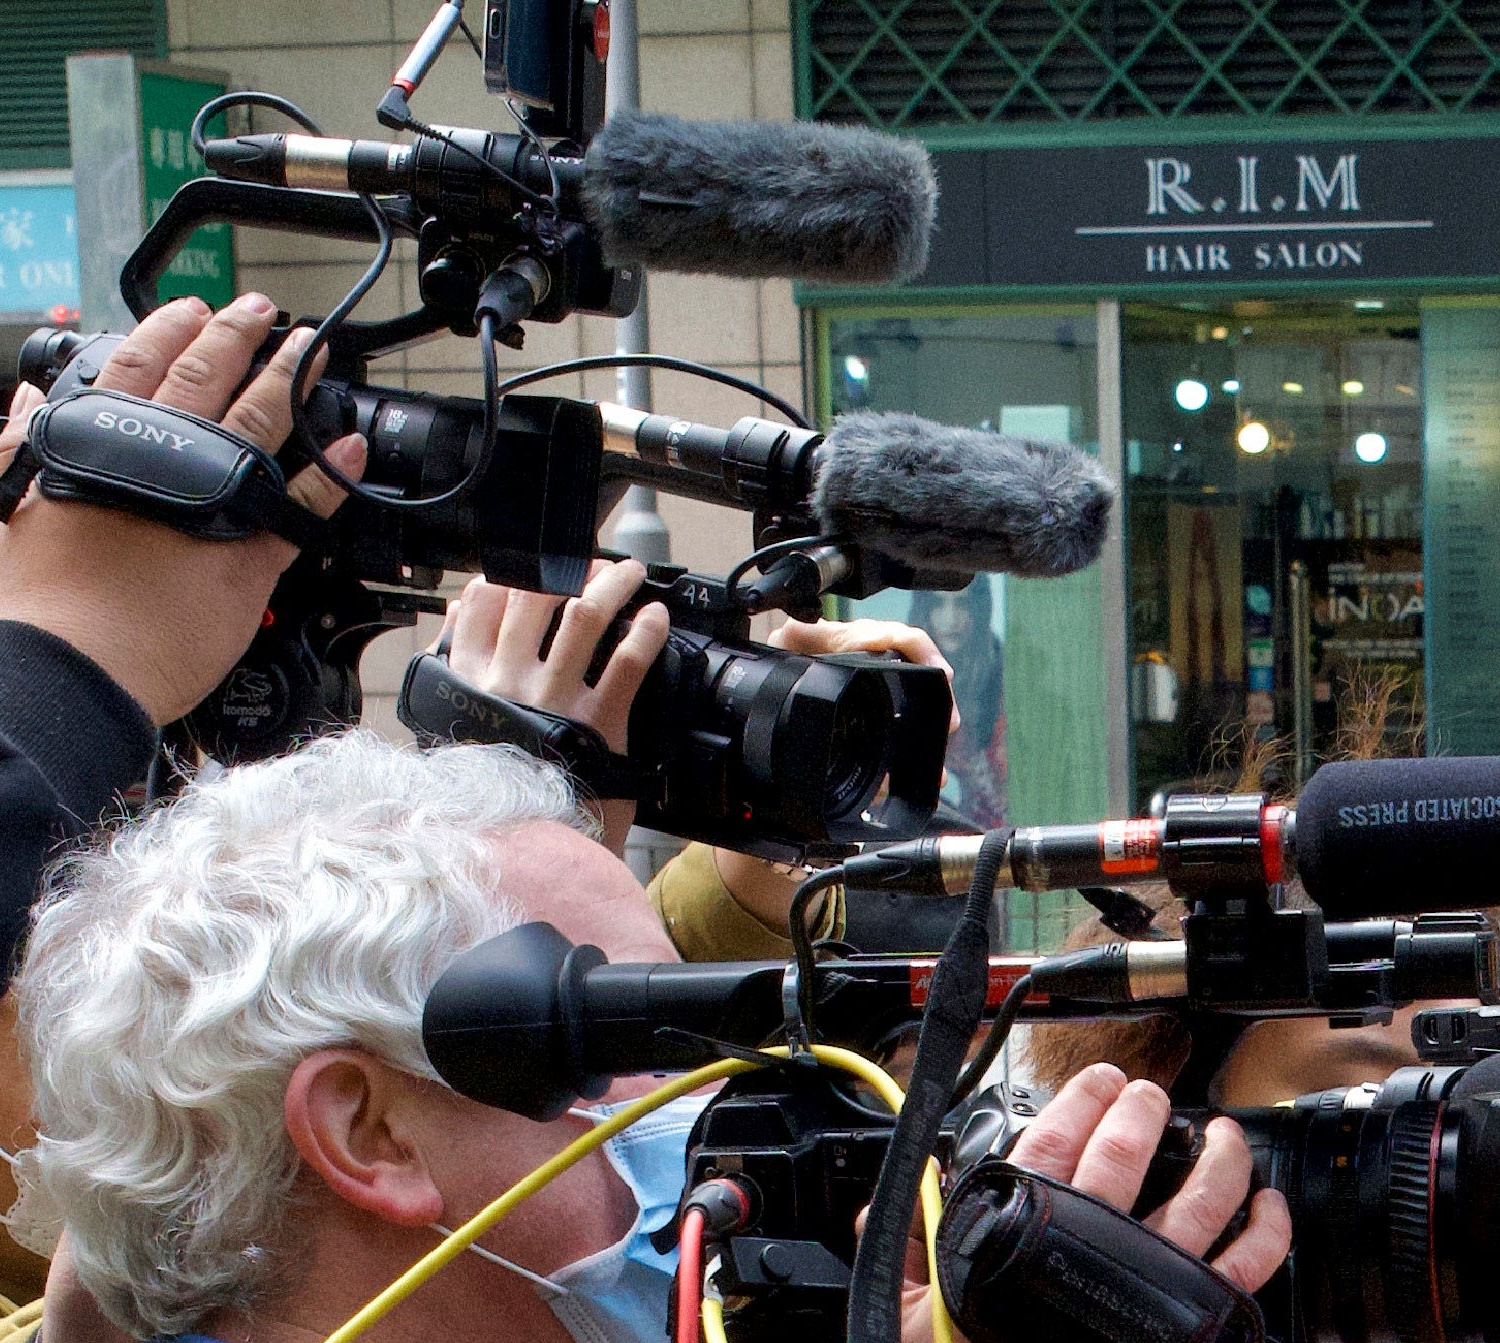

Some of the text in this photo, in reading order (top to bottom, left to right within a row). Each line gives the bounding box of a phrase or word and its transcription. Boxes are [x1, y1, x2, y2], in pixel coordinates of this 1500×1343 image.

[1145, 154, 1361, 214] R.I.M
[1145, 241, 1363, 272] HAIR SALON
[94, 411, 196, 452] SONY
[436, 681, 506, 729] SONY
[1338, 801, 1409, 828] PRESS
